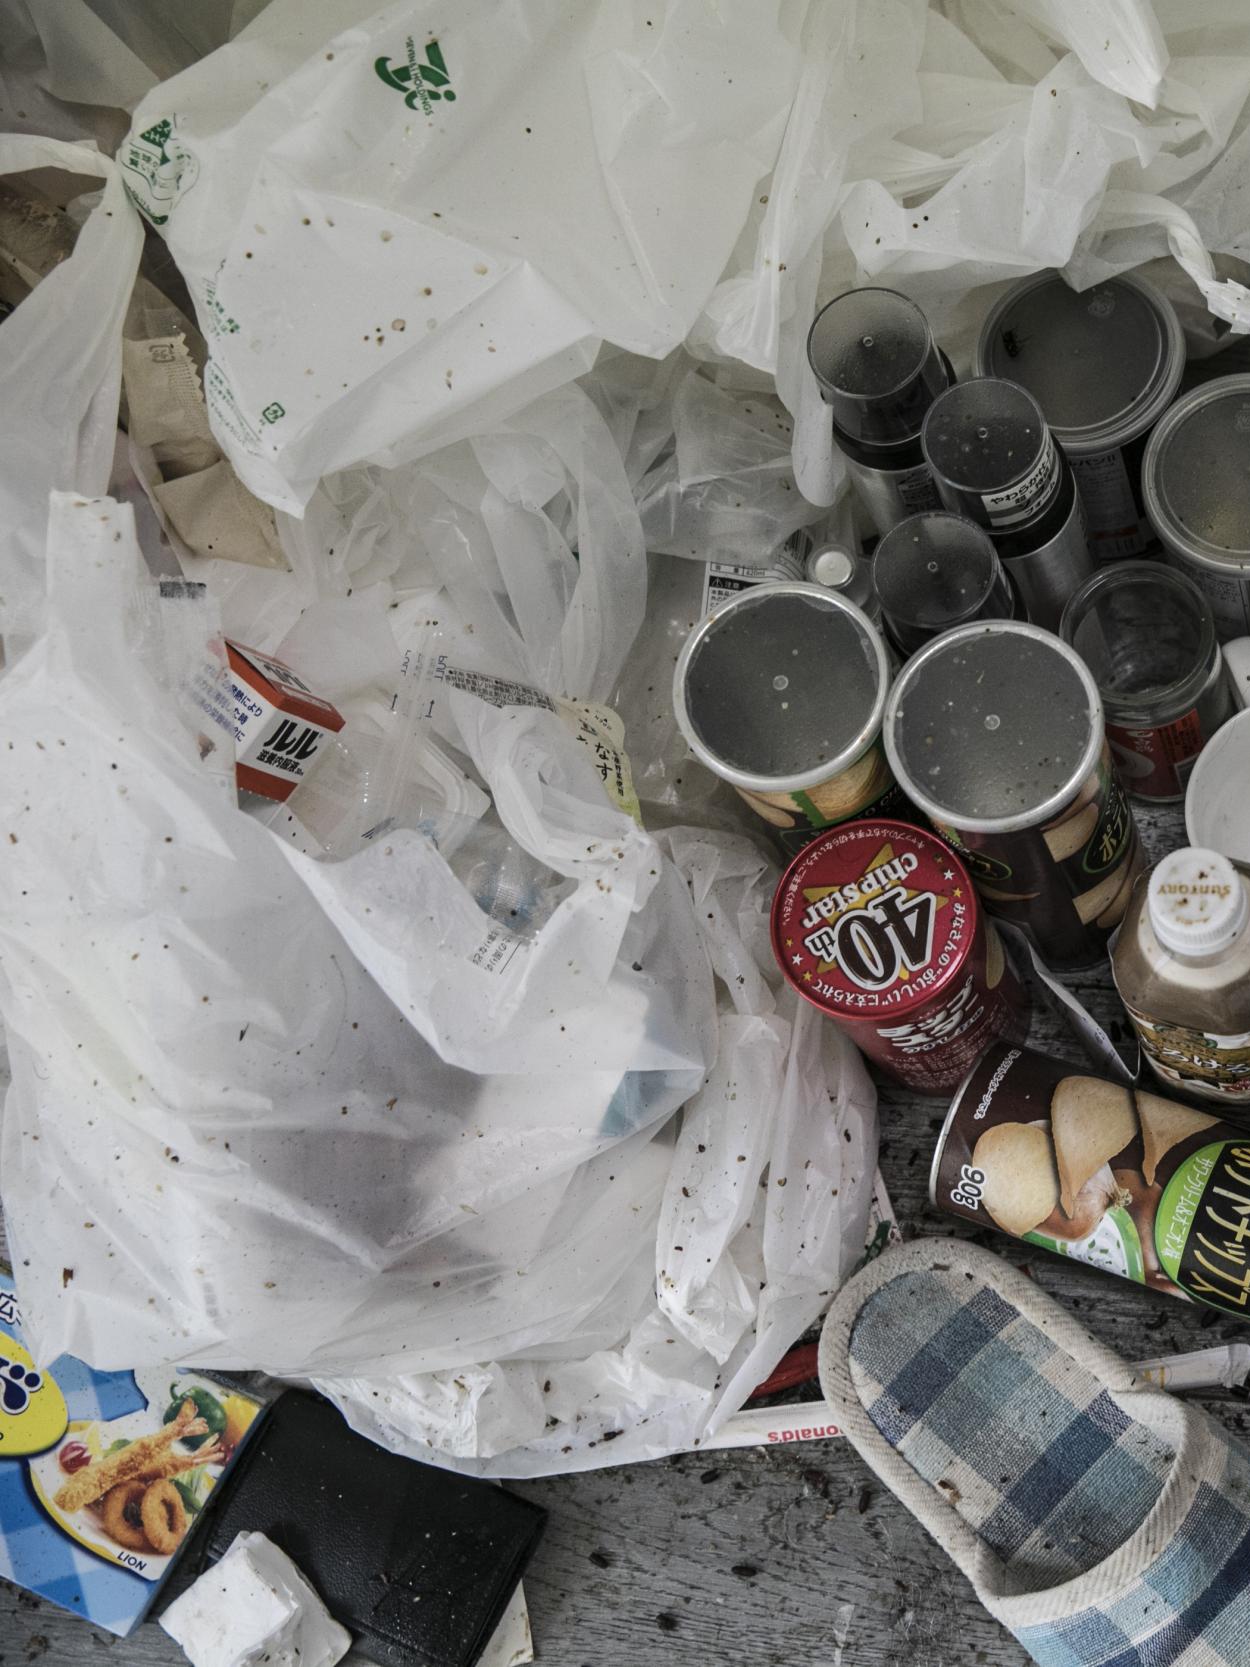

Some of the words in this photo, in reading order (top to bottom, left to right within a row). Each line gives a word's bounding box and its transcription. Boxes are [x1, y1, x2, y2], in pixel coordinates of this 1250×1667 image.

[411, 72, 432, 117] HOLDINGS
[265, 720, 323, 760] ルル
[593, 741, 614, 782] なす
[768, 1424, 841, 1444] onald's
[116, 1549, 148, 1573] LION
